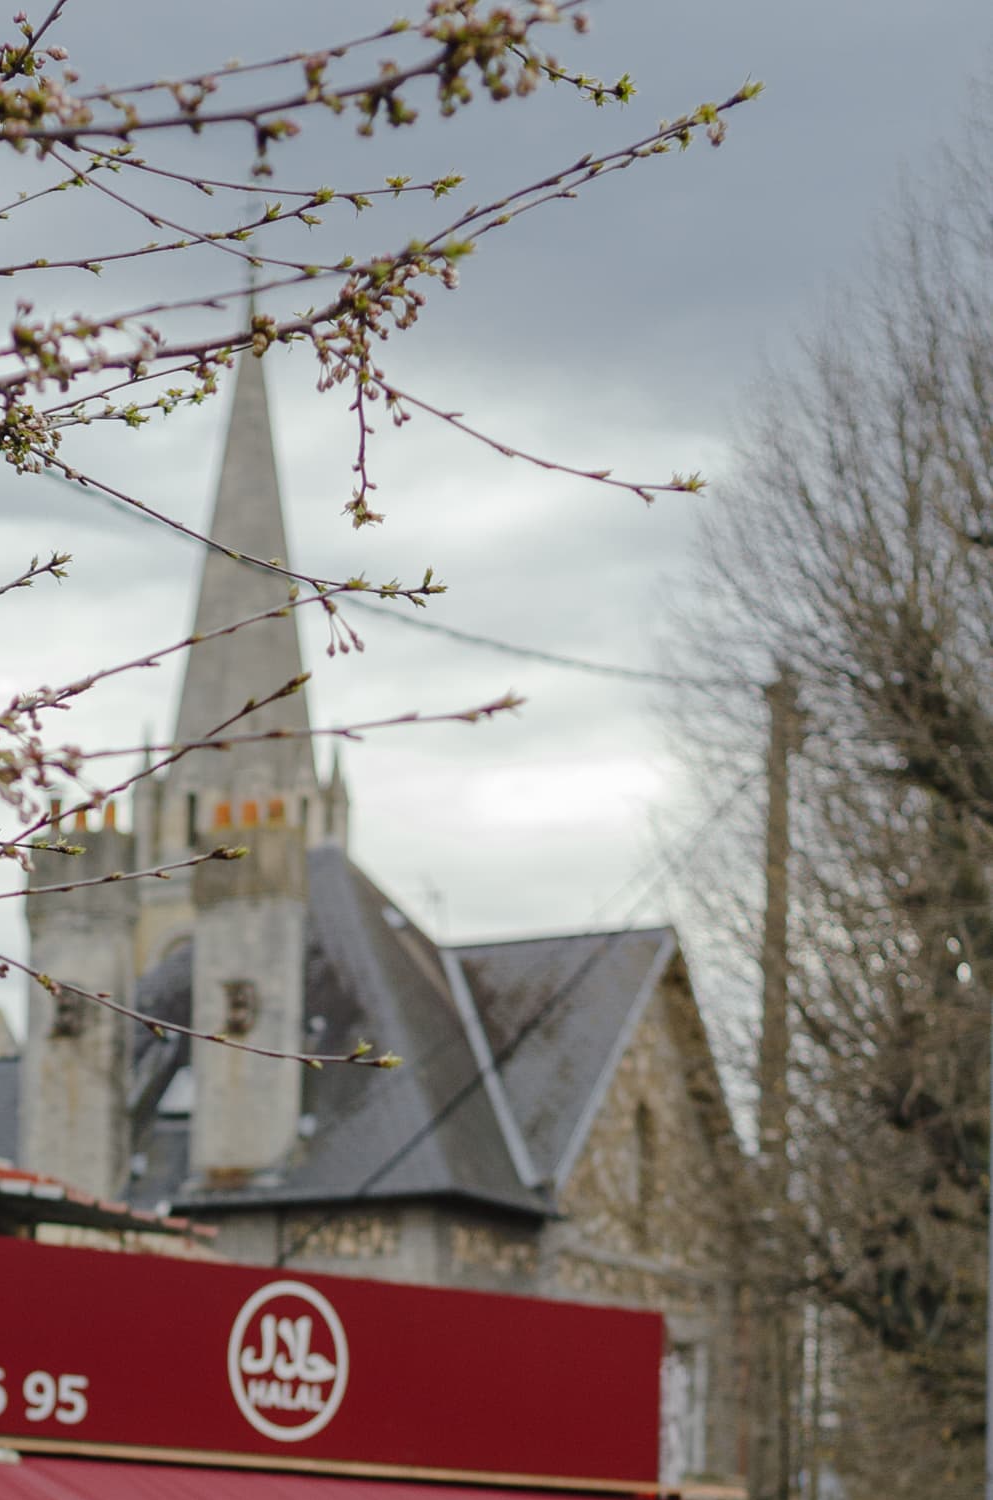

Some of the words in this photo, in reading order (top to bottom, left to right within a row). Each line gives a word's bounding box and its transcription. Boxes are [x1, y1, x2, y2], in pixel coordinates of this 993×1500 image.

[240, 1313, 337, 1383] حلال
[22, 1370, 89, 1425] 95
[247, 1378, 327, 1413] HALAL
